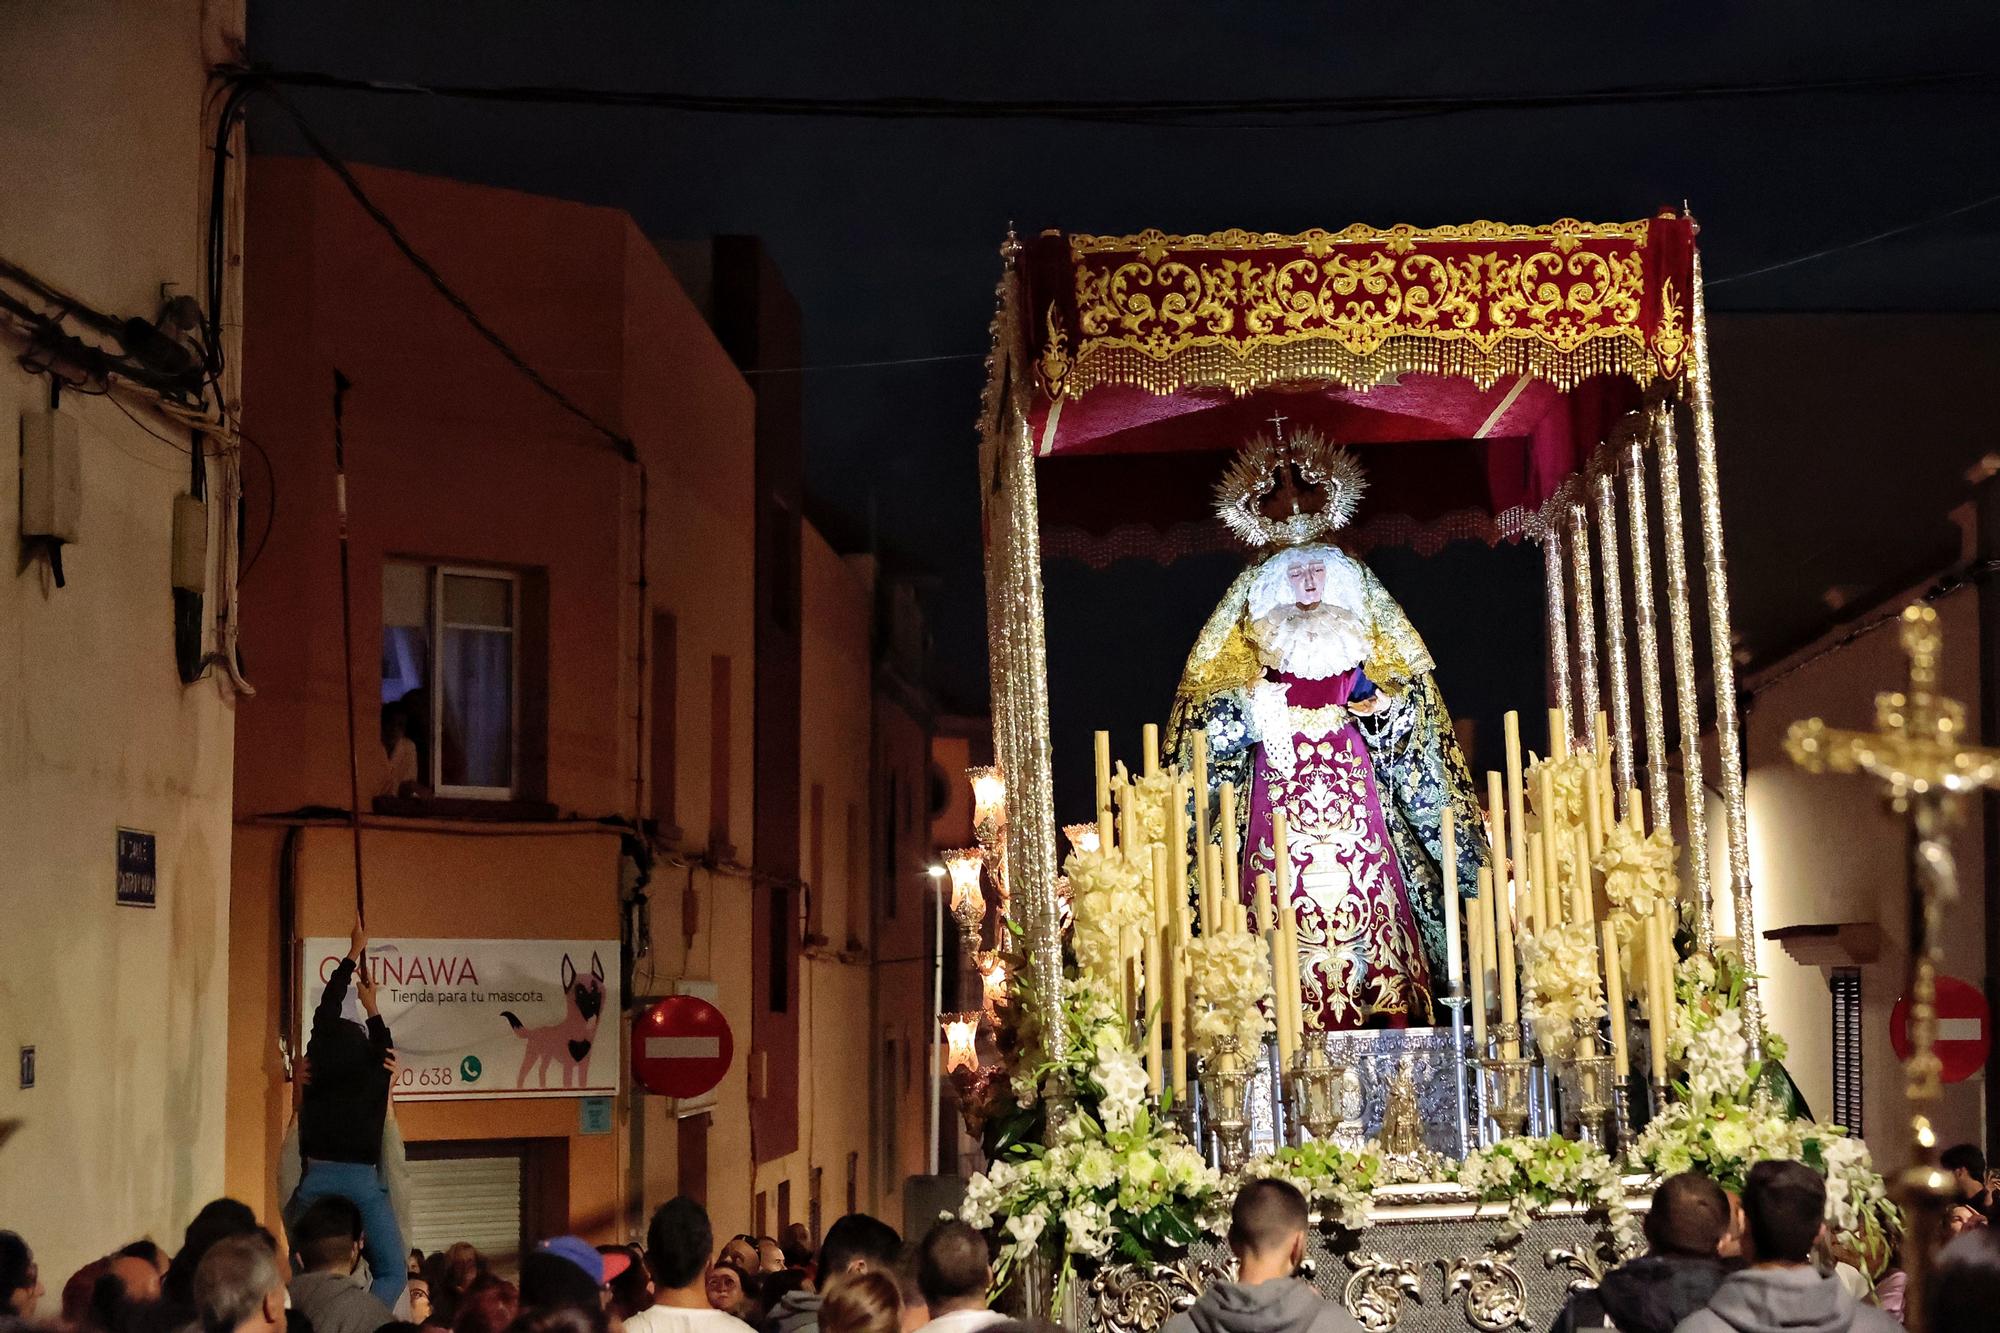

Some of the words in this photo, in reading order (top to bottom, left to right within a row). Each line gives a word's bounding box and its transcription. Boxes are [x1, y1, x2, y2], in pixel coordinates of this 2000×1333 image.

[390, 989, 434, 1003] Tienda
[437, 992, 467, 1006] para
[471, 990, 485, 1003] tu
[419, 1067, 453, 1086] 638
